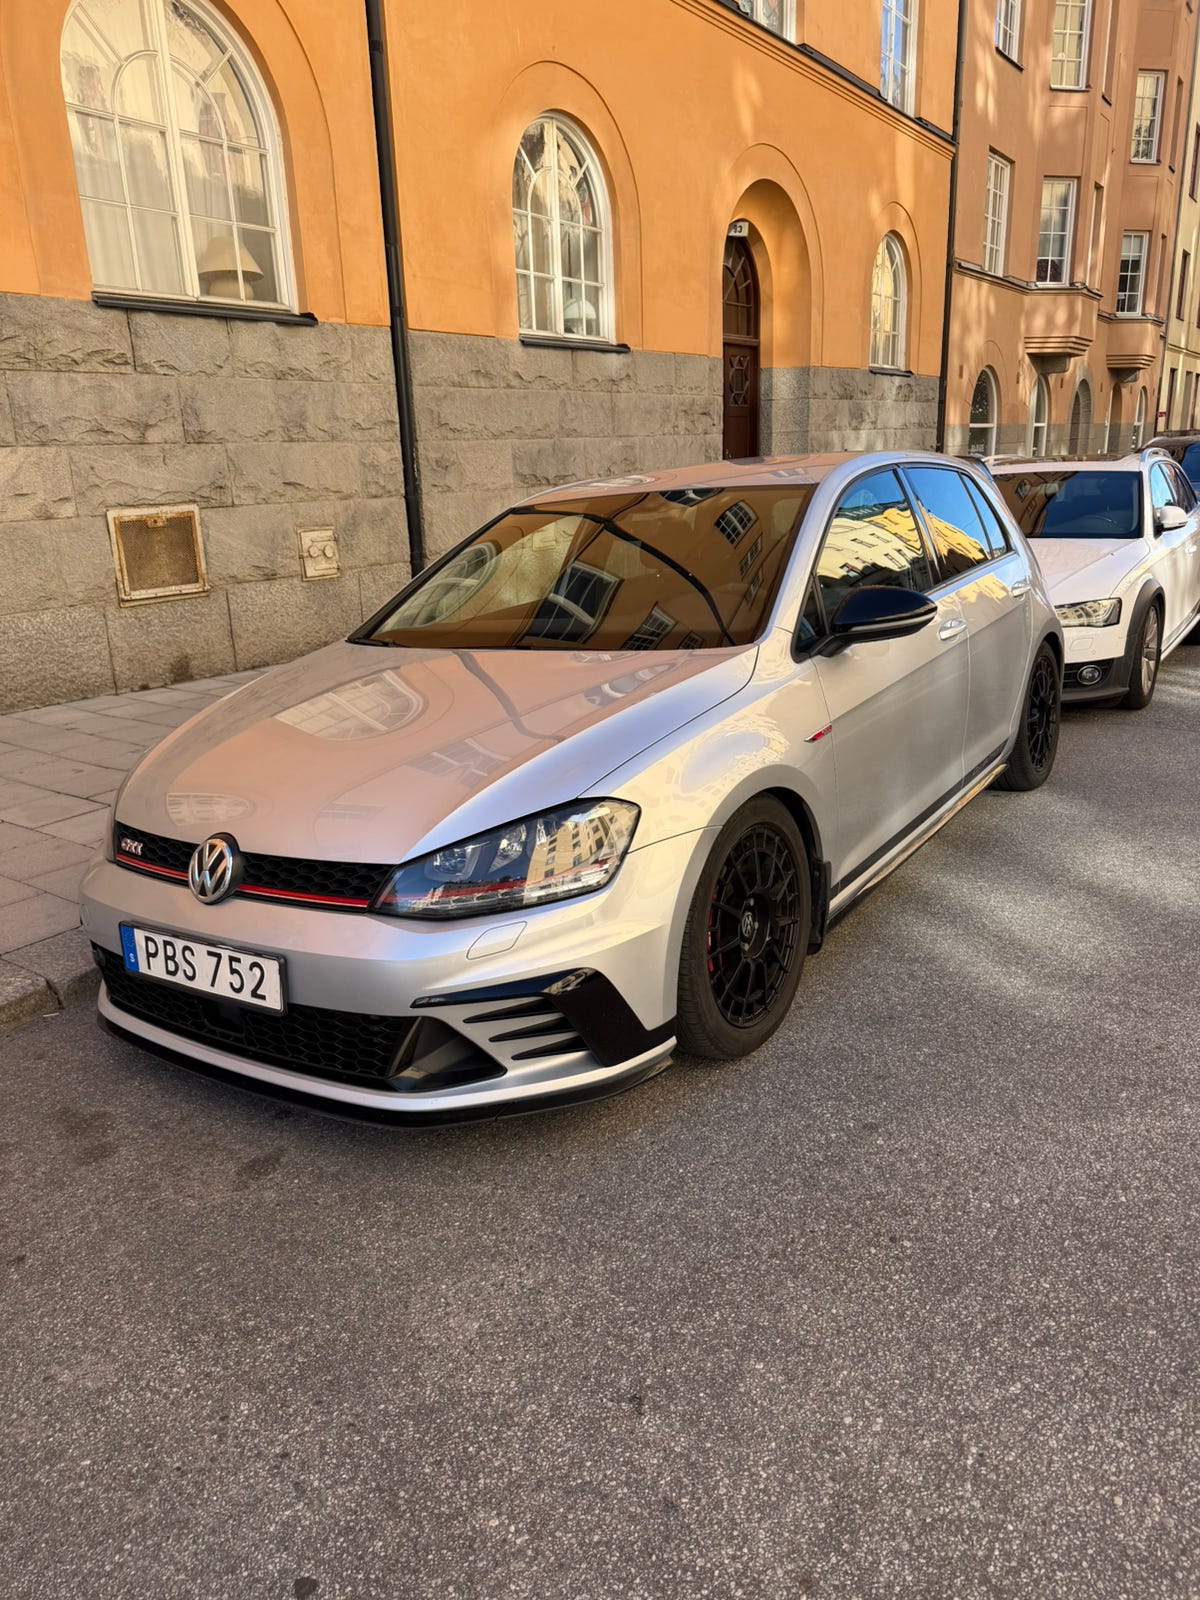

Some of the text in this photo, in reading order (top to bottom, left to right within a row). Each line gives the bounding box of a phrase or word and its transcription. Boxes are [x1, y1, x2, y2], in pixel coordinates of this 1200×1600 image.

[129, 952, 136, 963] S
[144, 935, 267, 1001] PBS 752
